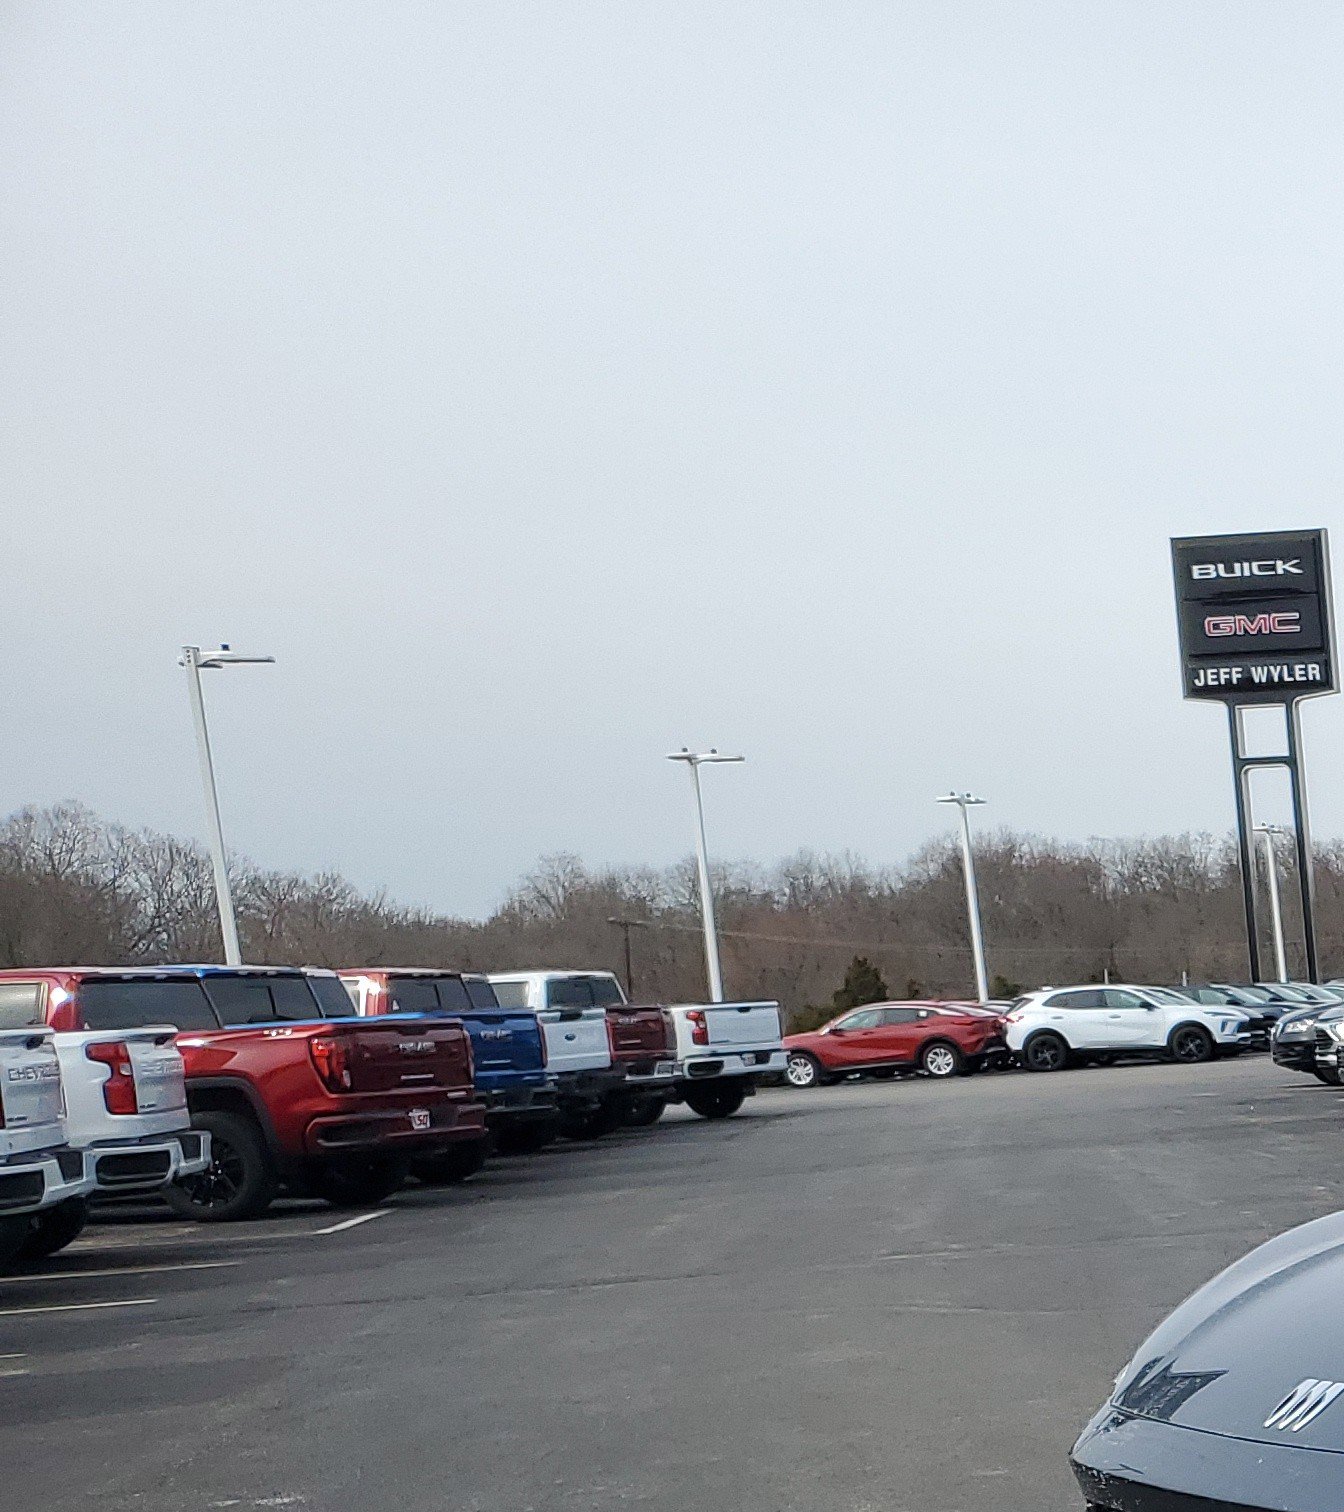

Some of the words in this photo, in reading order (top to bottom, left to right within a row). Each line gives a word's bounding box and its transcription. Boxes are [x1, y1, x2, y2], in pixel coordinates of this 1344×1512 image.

[1191, 559, 1303, 580] BUICK
[1204, 612, 1301, 637] GMC
[1193, 667, 1243, 687] JEFF
[1250, 663, 1321, 684] WYLER
